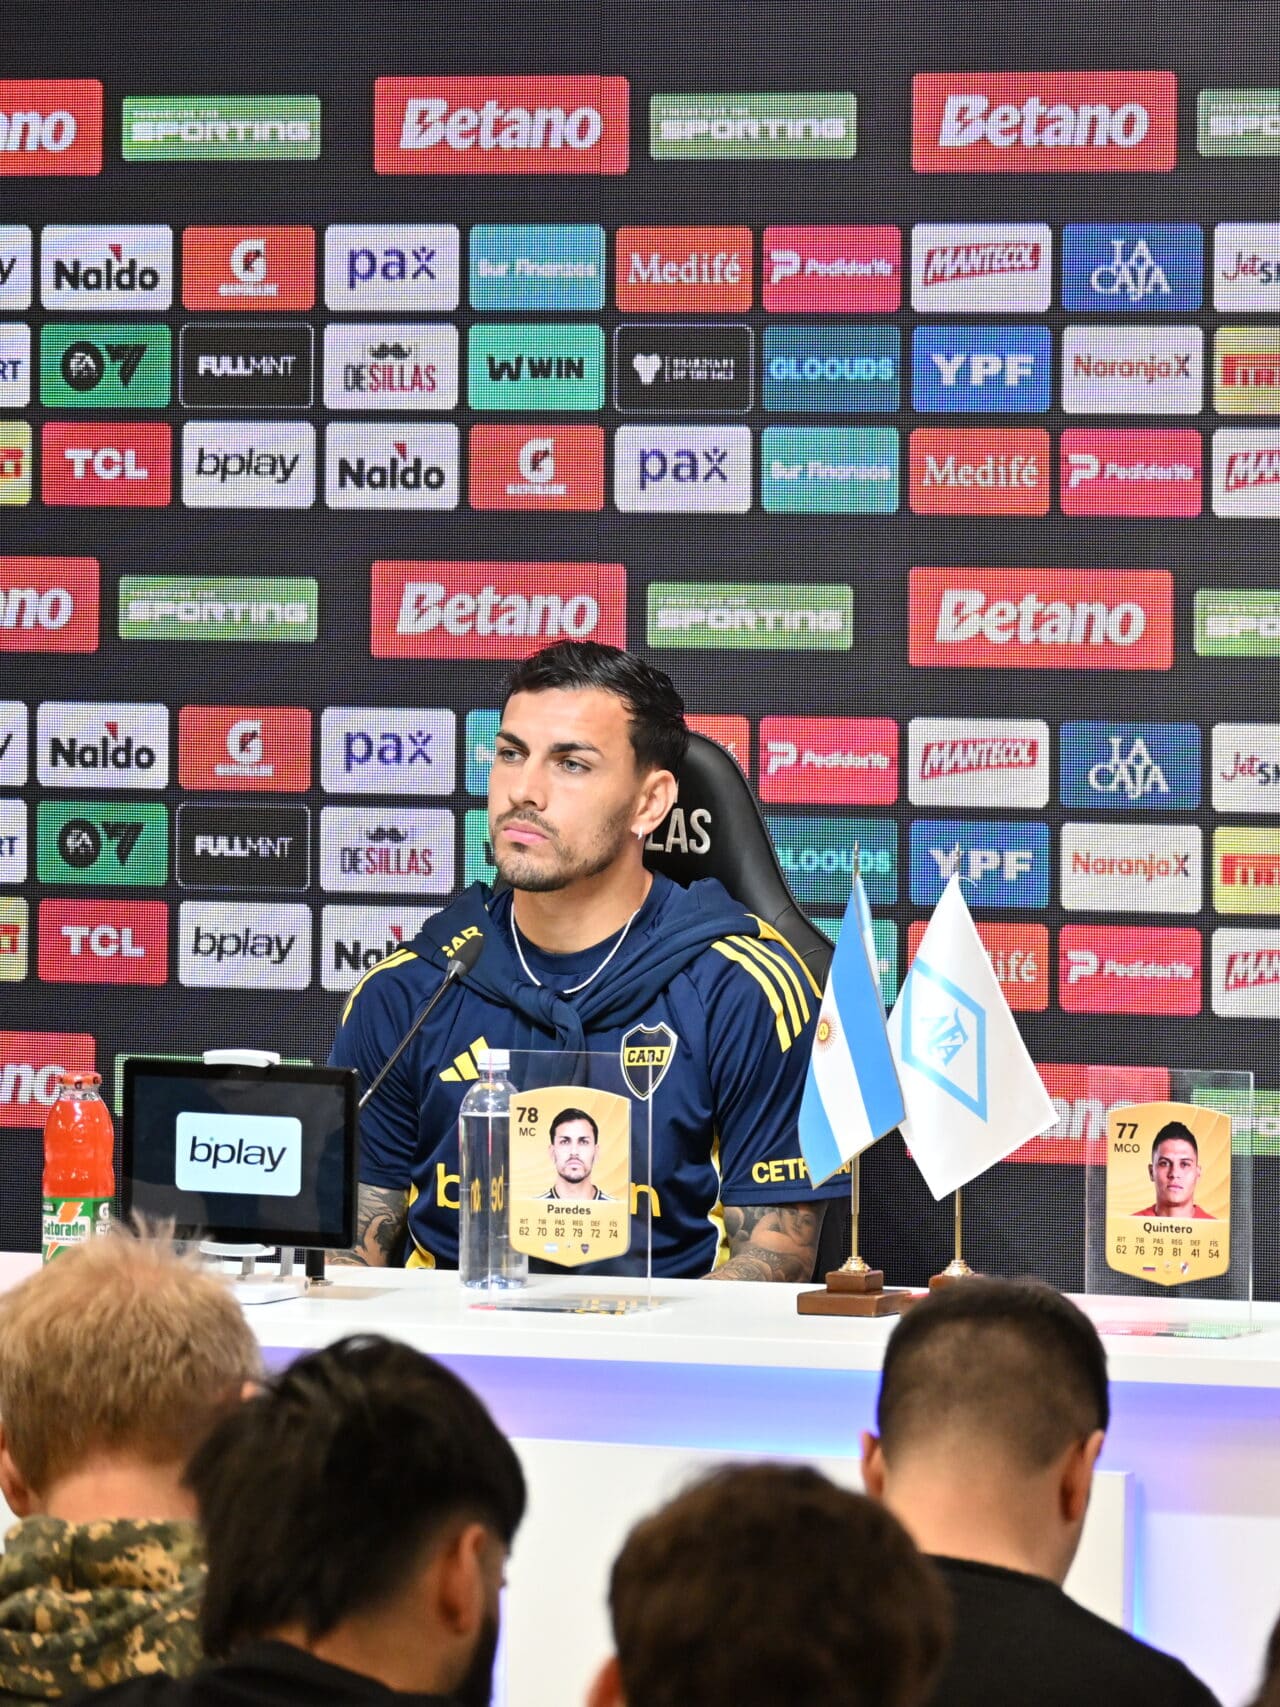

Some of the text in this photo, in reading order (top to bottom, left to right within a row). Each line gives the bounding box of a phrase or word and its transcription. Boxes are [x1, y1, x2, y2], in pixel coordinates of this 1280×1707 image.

[131, 120, 312, 143] SPORTING
[400, 98, 602, 149] Betano
[659, 117, 845, 141] SPORTING
[939, 95, 1148, 147] Betano
[54, 259, 159, 291] Naldo
[348, 247, 435, 290] pax
[628, 252, 741, 284] Medifé
[932, 354, 1033, 386] YPF
[65, 448, 148, 480] TCL
[196, 448, 299, 484] bplay
[338, 458, 445, 490] Naldo
[639, 448, 727, 490] pax
[923, 455, 1038, 487] Medifé
[128, 600, 308, 623] SPORTING
[396, 582, 600, 637] Betano
[655, 607, 842, 632] SPORTING
[936, 589, 1145, 645] Betano
[50, 737, 155, 769] Naldo
[344, 731, 432, 772] pax
[930, 849, 1033, 881] YPF
[61, 925, 145, 957] TCL
[192, 927, 295, 965] bplay
[516, 1107, 539, 1123] 78
[1116, 1123, 1139, 1139] 77
[519, 1127, 537, 1137] MC
[1114, 1143, 1140, 1153] MCO
[189, 1136, 287, 1172] bplay
[547, 1204, 592, 1215] Paredes
[519, 1226, 619, 1239] 62 70 82 79 72 74
[1143, 1222, 1193, 1235] Quintero
[1115, 1245, 1220, 1259] 62 76 79 81 41 54
